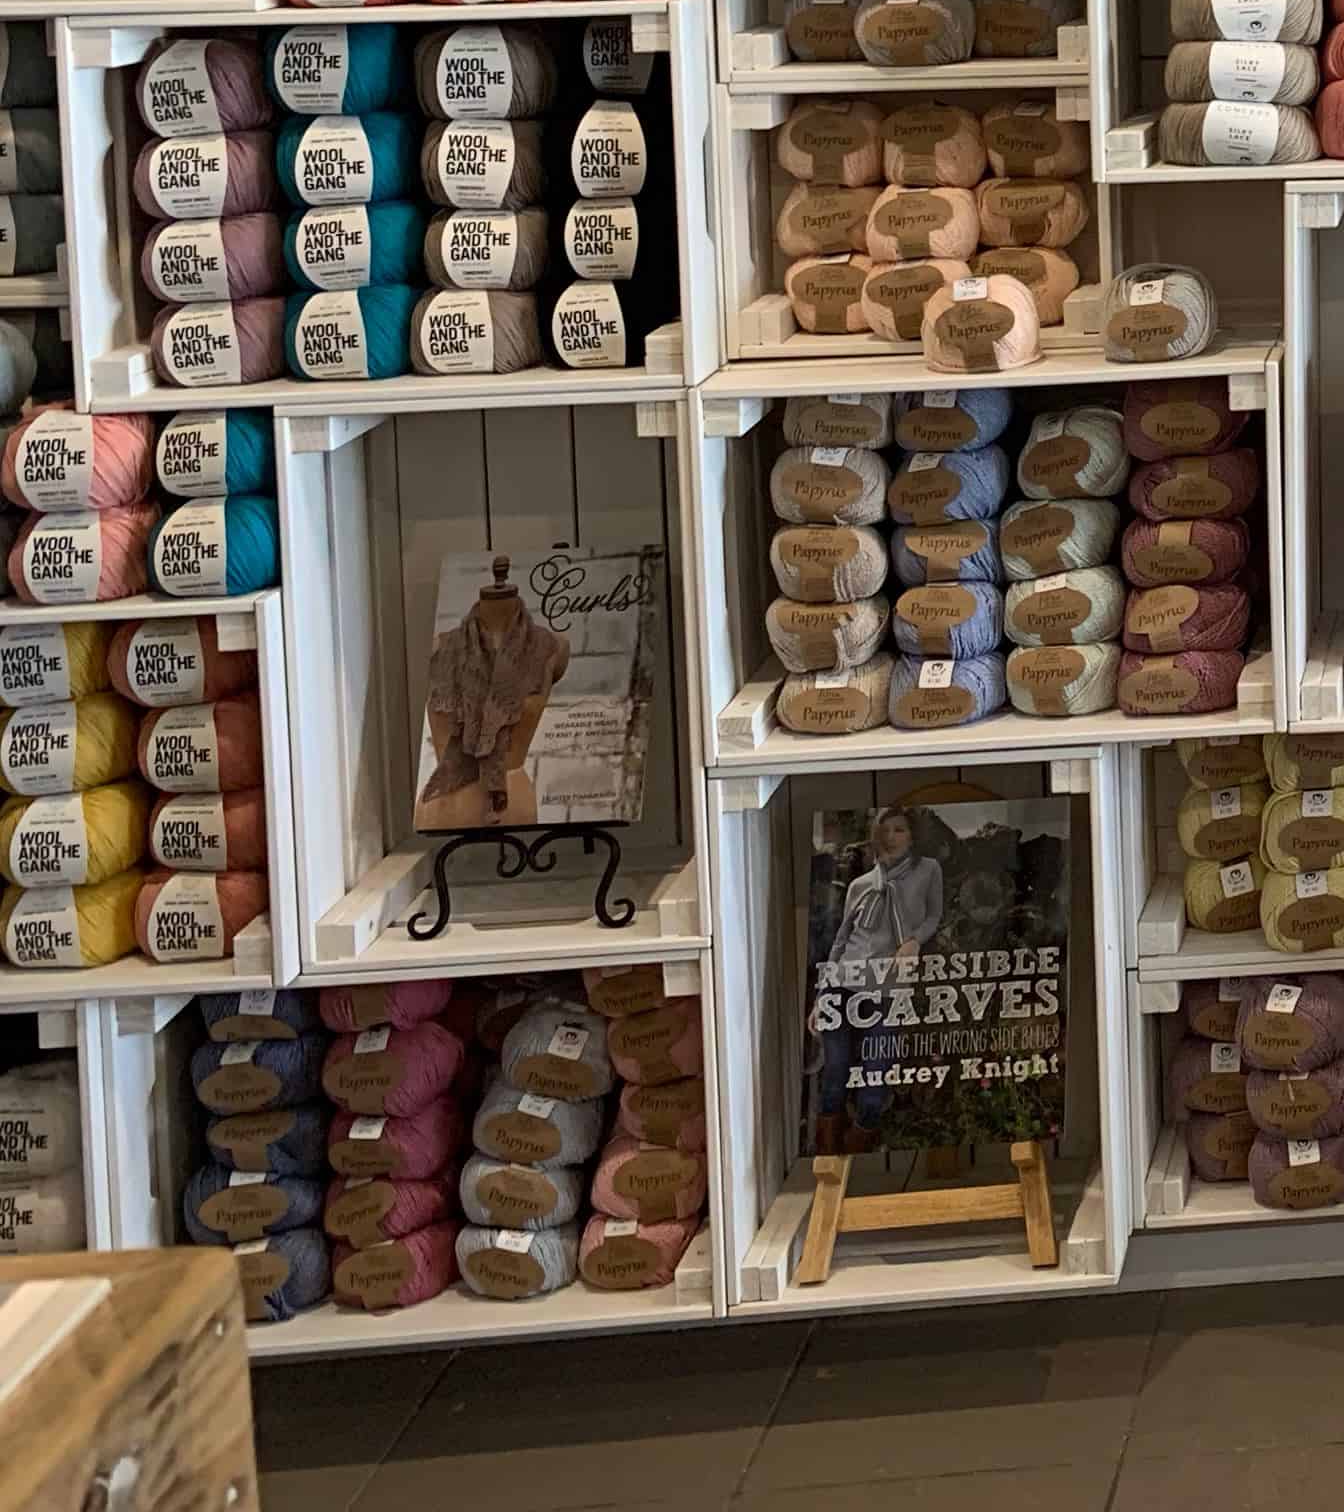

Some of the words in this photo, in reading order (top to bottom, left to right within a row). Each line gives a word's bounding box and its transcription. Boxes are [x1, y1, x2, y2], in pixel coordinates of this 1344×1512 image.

[284, 42, 324, 55] WOOL
[282, 56, 312, 69] AND
[314, 55, 342, 69] THE
[282, 69, 321, 84] GANG
[580, 138, 622, 152] WOOL
[580, 152, 610, 166] AND
[613, 152, 640, 166] THE
[580, 166, 620, 179] GANG
[26, 438, 68, 453] WOOL
[24, 453, 55, 468] AND
[58, 451, 86, 465] THE
[24, 466, 66, 482] GANG
[163, 532, 203, 547] WOOL
[162, 547, 192, 563] AND
[194, 544, 219, 559] THE
[162, 560, 200, 576] GANG
[530, 554, 649, 632] Curls
[11, 722, 51, 738] WOOL
[9, 738, 39, 754] AND
[42, 734, 69, 751] THE
[9, 752, 49, 768] GANG
[815, 946, 1060, 988] REVERSIBLE
[816, 979, 1060, 1031] SCARVES
[861, 1032, 911, 1060] CURING
[913, 1031, 938, 1057] THE
[939, 1028, 988, 1056] WRONG
[990, 1028, 1020, 1051] SIDE
[1022, 1022, 1060, 1050] BLUES
[846, 1063, 950, 1088] Audrey
[960, 1053, 1059, 1082] Knight
